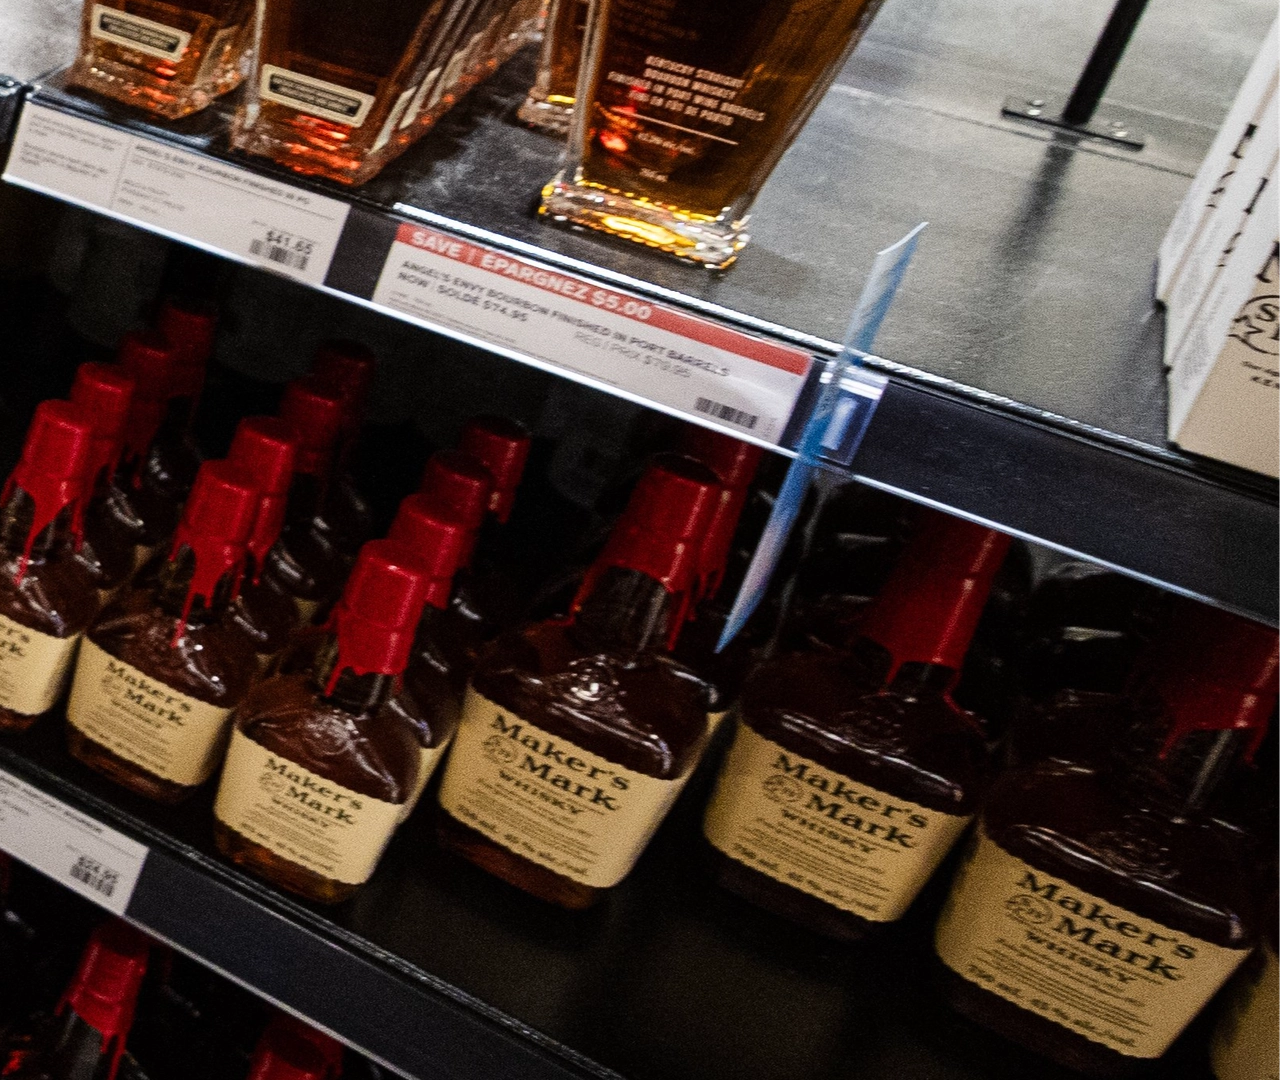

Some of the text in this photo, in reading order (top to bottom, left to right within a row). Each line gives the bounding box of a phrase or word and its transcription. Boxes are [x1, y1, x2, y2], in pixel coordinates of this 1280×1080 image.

[397, 271, 430, 288] NOW
[437, 284, 481, 306] SOLDE
[411, 231, 652, 320] SAVE ÉPARGNEZ $5.00
[452, 275, 485, 293] ENVY
[486, 287, 550, 315] BOURBON
[550, 308, 609, 336] FINISHED
[630, 337, 665, 354] PORT
[665, 349, 730, 377] BARRELS
[106, 660, 192, 713] Maker's
[125, 689, 185, 726] Mark
[490, 714, 631, 791] Maker's
[264, 757, 363, 810] Maker's
[285, 785, 355, 826] Mark
[498, 770, 586, 815] WHISKY
[518, 753, 622, 812] Mark
[770, 754, 930, 829] Maker's
[781, 809, 877, 855] WHISKY
[803, 792, 918, 850] Mark
[1015, 870, 1199, 961] Maker's
[1025, 929, 1139, 985] WHISKY
[1050, 913, 1186, 982] Mark
